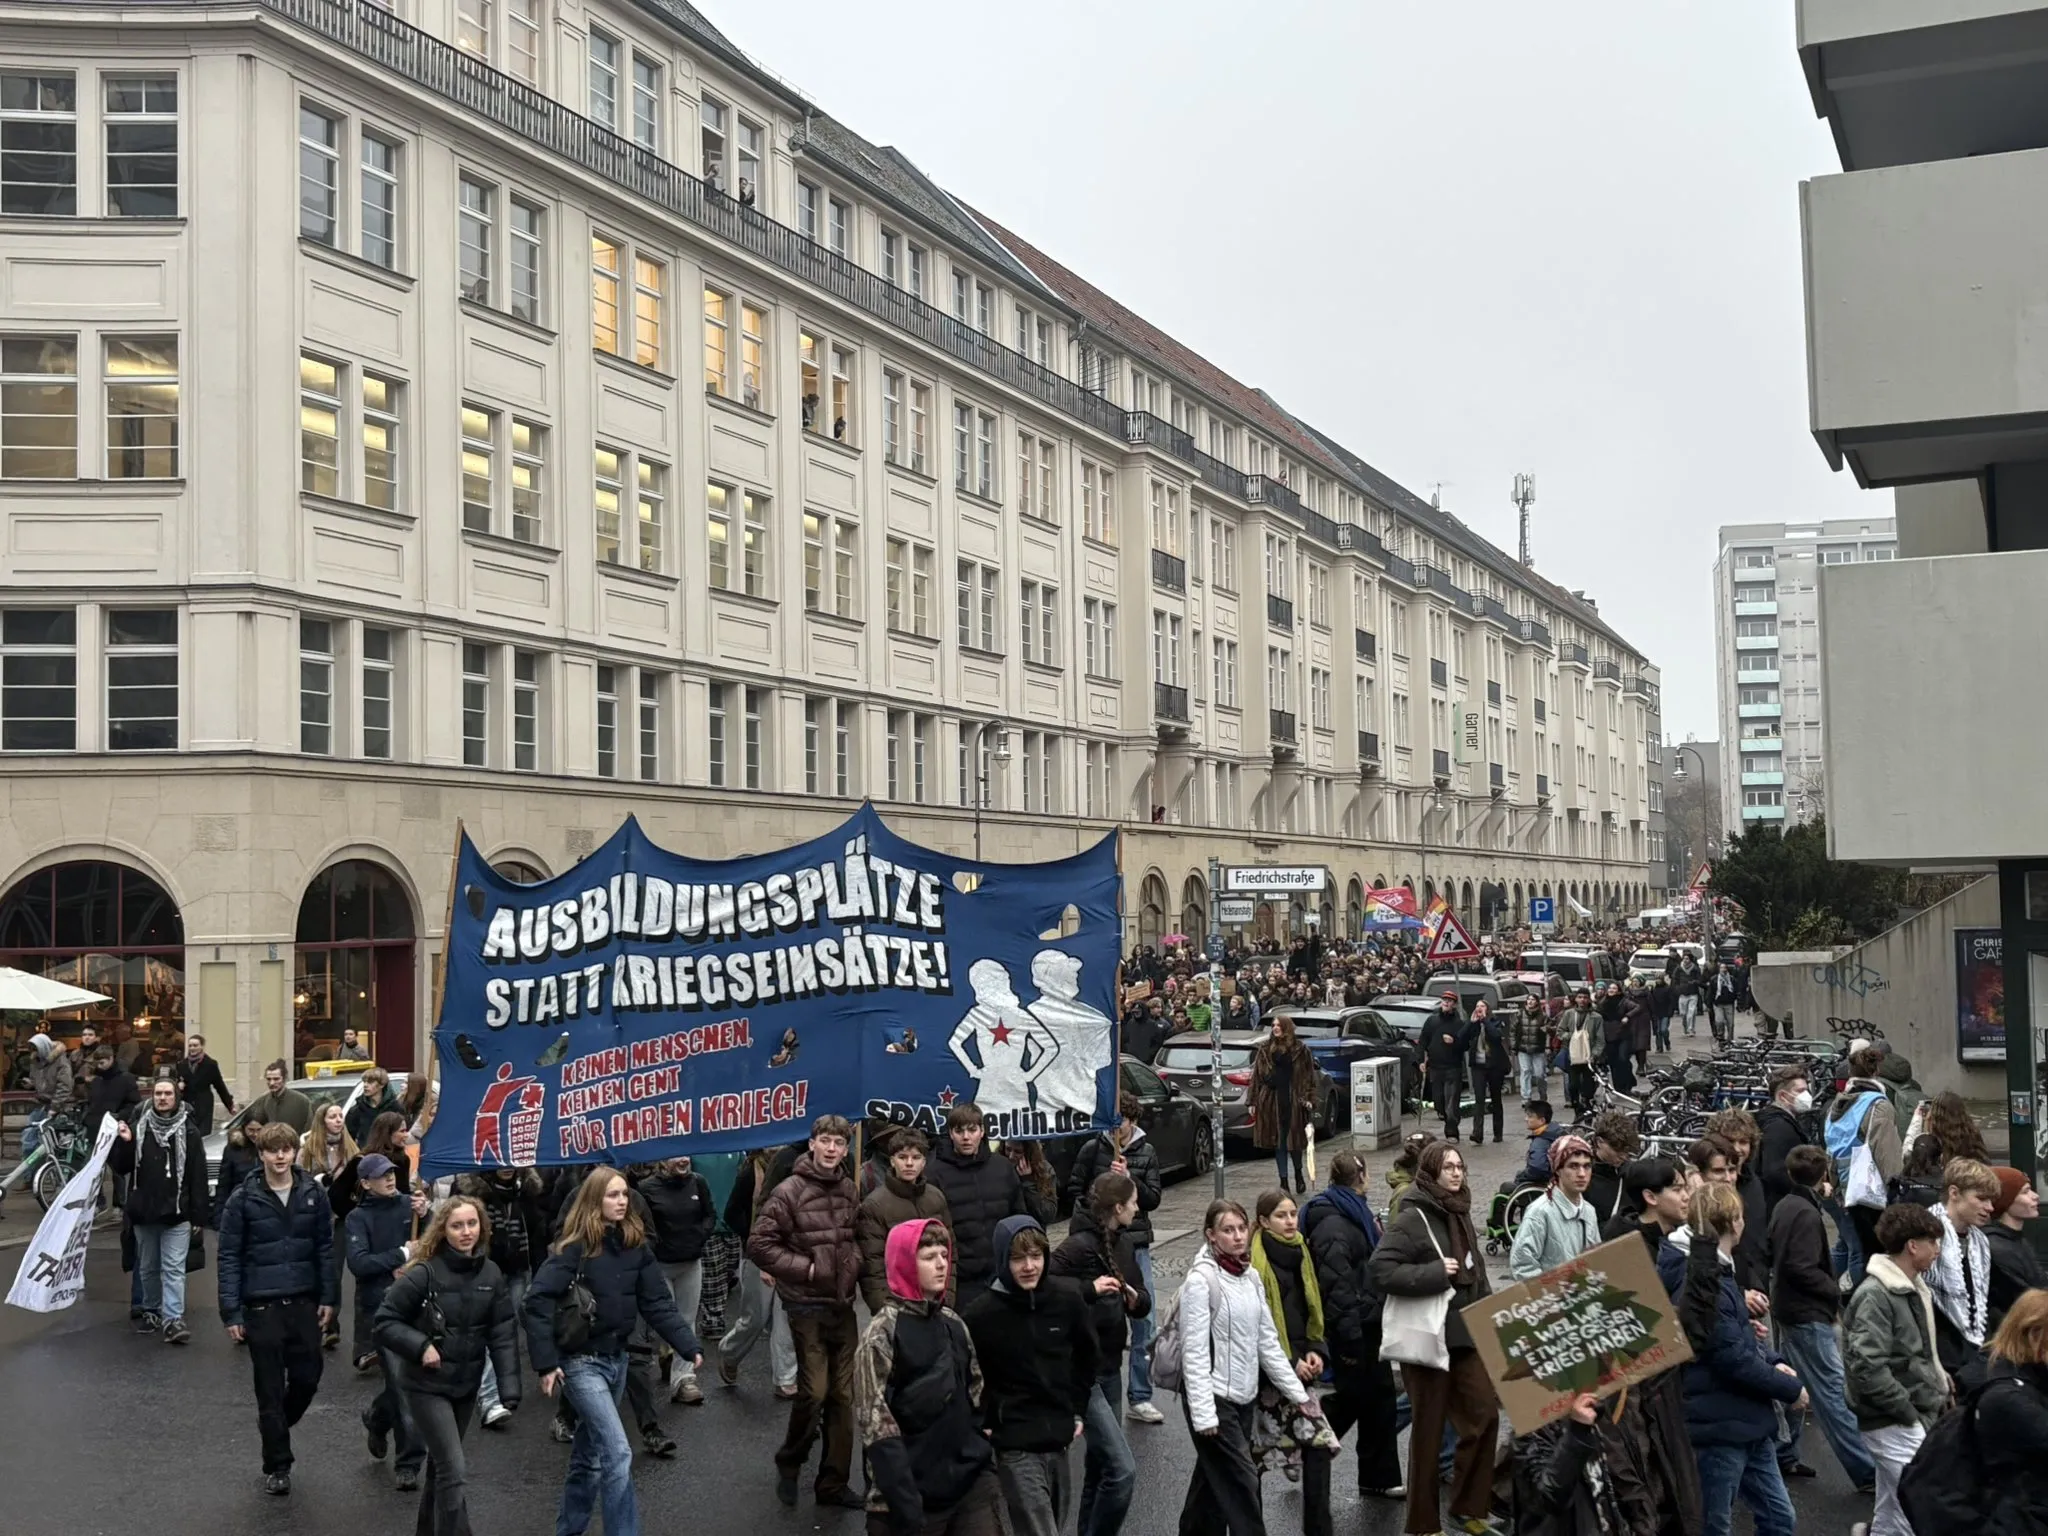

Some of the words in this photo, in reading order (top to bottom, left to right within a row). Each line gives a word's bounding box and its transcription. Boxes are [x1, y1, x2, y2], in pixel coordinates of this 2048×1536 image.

[1465, 712, 1479, 751] Garner
[481, 833, 945, 963] AUSBILDUNGSPLÄTZE
[1235, 870, 1315, 886] Friedrichstraße
[485, 962, 606, 1029] STATT
[611, 926, 952, 1009] KRIEGSEINSÄTZE!
[561, 1045, 628, 1088] KEINEN
[631, 1017, 753, 1069] MENSCHEN,
[557, 1078, 625, 1119] KEINEN
[628, 1064, 682, 1101] CENT
[560, 1116, 607, 1158] FÜR
[612, 1099, 692, 1147] IHREN
[700, 1080, 809, 1133] KRIEG!
[1525, 1331, 1582, 1366] ETWAS
[1579, 1306, 1637, 1342] GEGEN
[1533, 1346, 1586, 1380] KRIEG
[1586, 1319, 1649, 1359] HABEN
